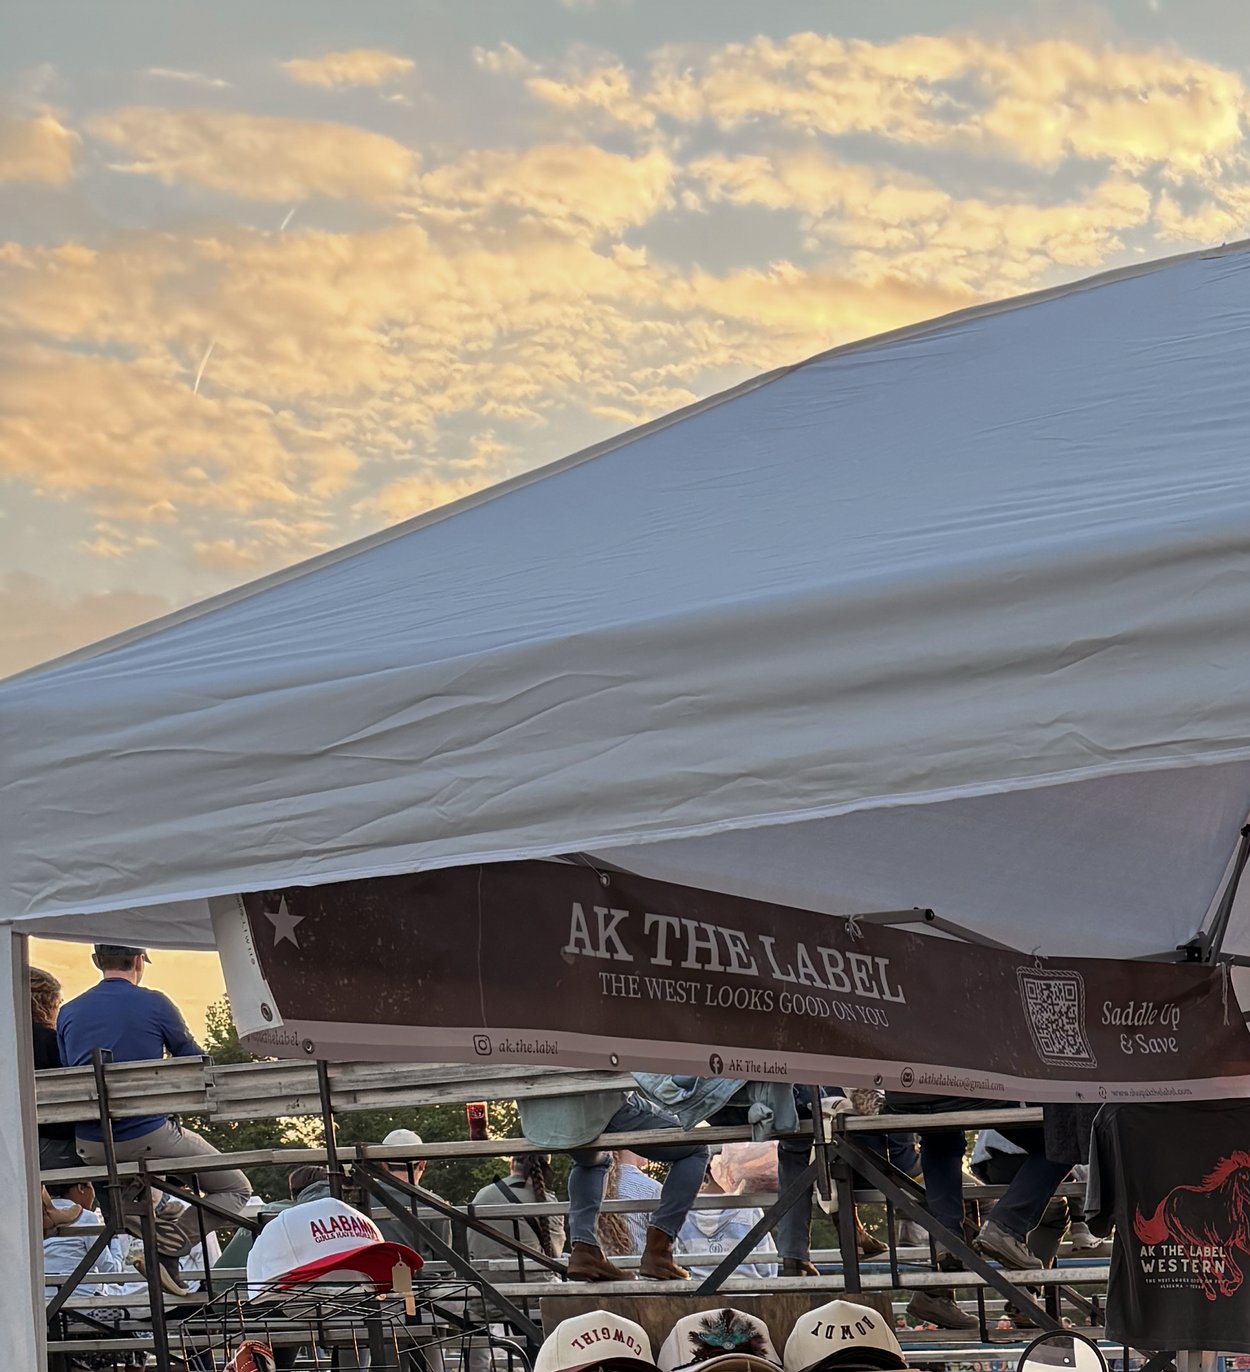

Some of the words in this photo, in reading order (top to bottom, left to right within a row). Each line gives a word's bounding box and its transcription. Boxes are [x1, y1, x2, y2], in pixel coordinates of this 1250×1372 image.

[565, 902, 634, 962] AK
[644, 913, 759, 976] THE
[759, 935, 906, 1003] LABEL
[599, 972, 642, 998] THE
[643, 978, 700, 1004] WEST
[705, 983, 774, 1011] LOOKS
[780, 992, 831, 1017] GOOD
[832, 1000, 856, 1022] ON
[856, 1005, 889, 1027] YOU
[1102, 1001, 1157, 1026] Saddle
[1160, 1003, 1180, 1031] Up
[499, 1039, 559, 1057] ak.the.label
[1120, 1034, 1132, 1054] &
[1135, 1033, 1178, 1054] Save
[728, 1059, 743, 1072] AK
[745, 1060, 761, 1073] The
[763, 1062, 788, 1075] Label
[1140, 1246, 1156, 1257] AK
[1161, 1245, 1184, 1257] THE
[1190, 1246, 1226, 1258] LABEL
[1140, 1259, 1225, 1273] WESTERN
[811, 1315, 876, 1340] ROWDY
[571, 1327, 642, 1356] COWGIRL
